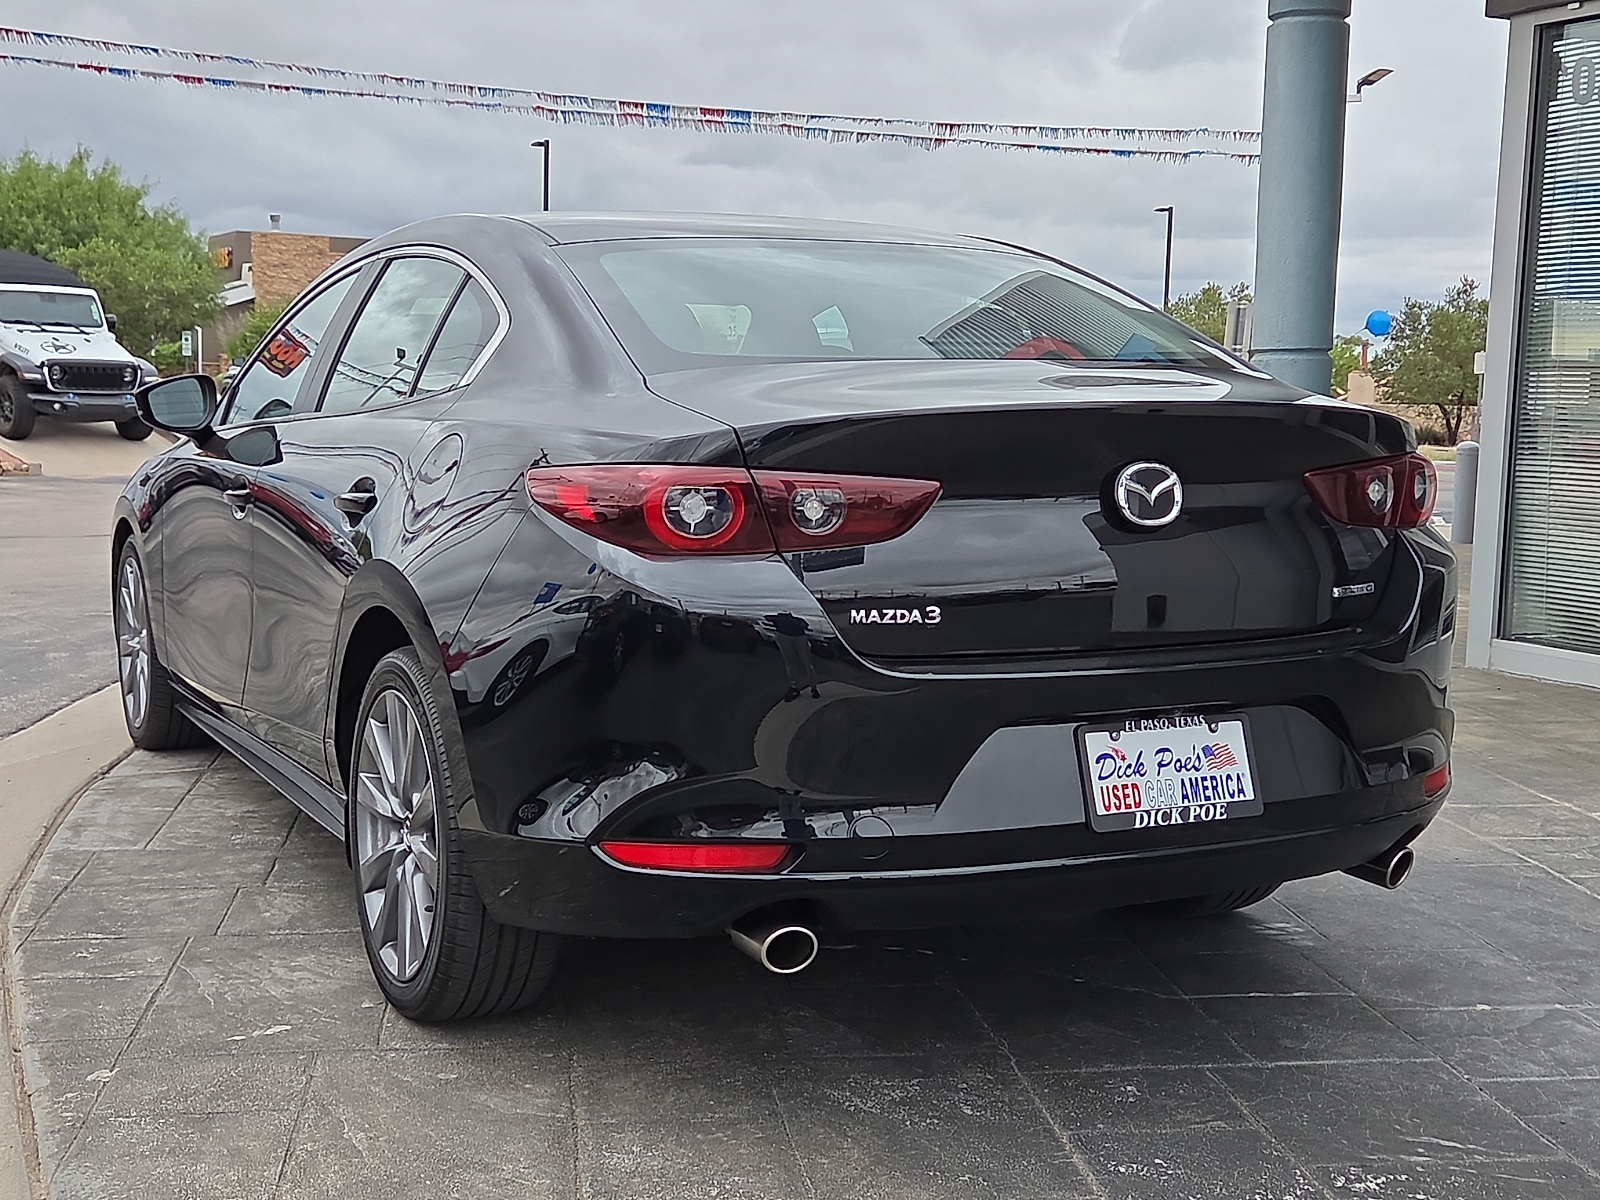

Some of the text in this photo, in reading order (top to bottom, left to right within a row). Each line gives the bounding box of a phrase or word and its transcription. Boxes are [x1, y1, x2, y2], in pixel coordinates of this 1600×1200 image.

[1125, 720, 1137, 732] EL
[1174, 714, 1206, 729] TEXAS
[1095, 744, 1204, 781] Dick Poe's
[1101, 773, 1246, 811] USED CAR AMERICA
[1133, 803, 1227, 828] DICK POE
